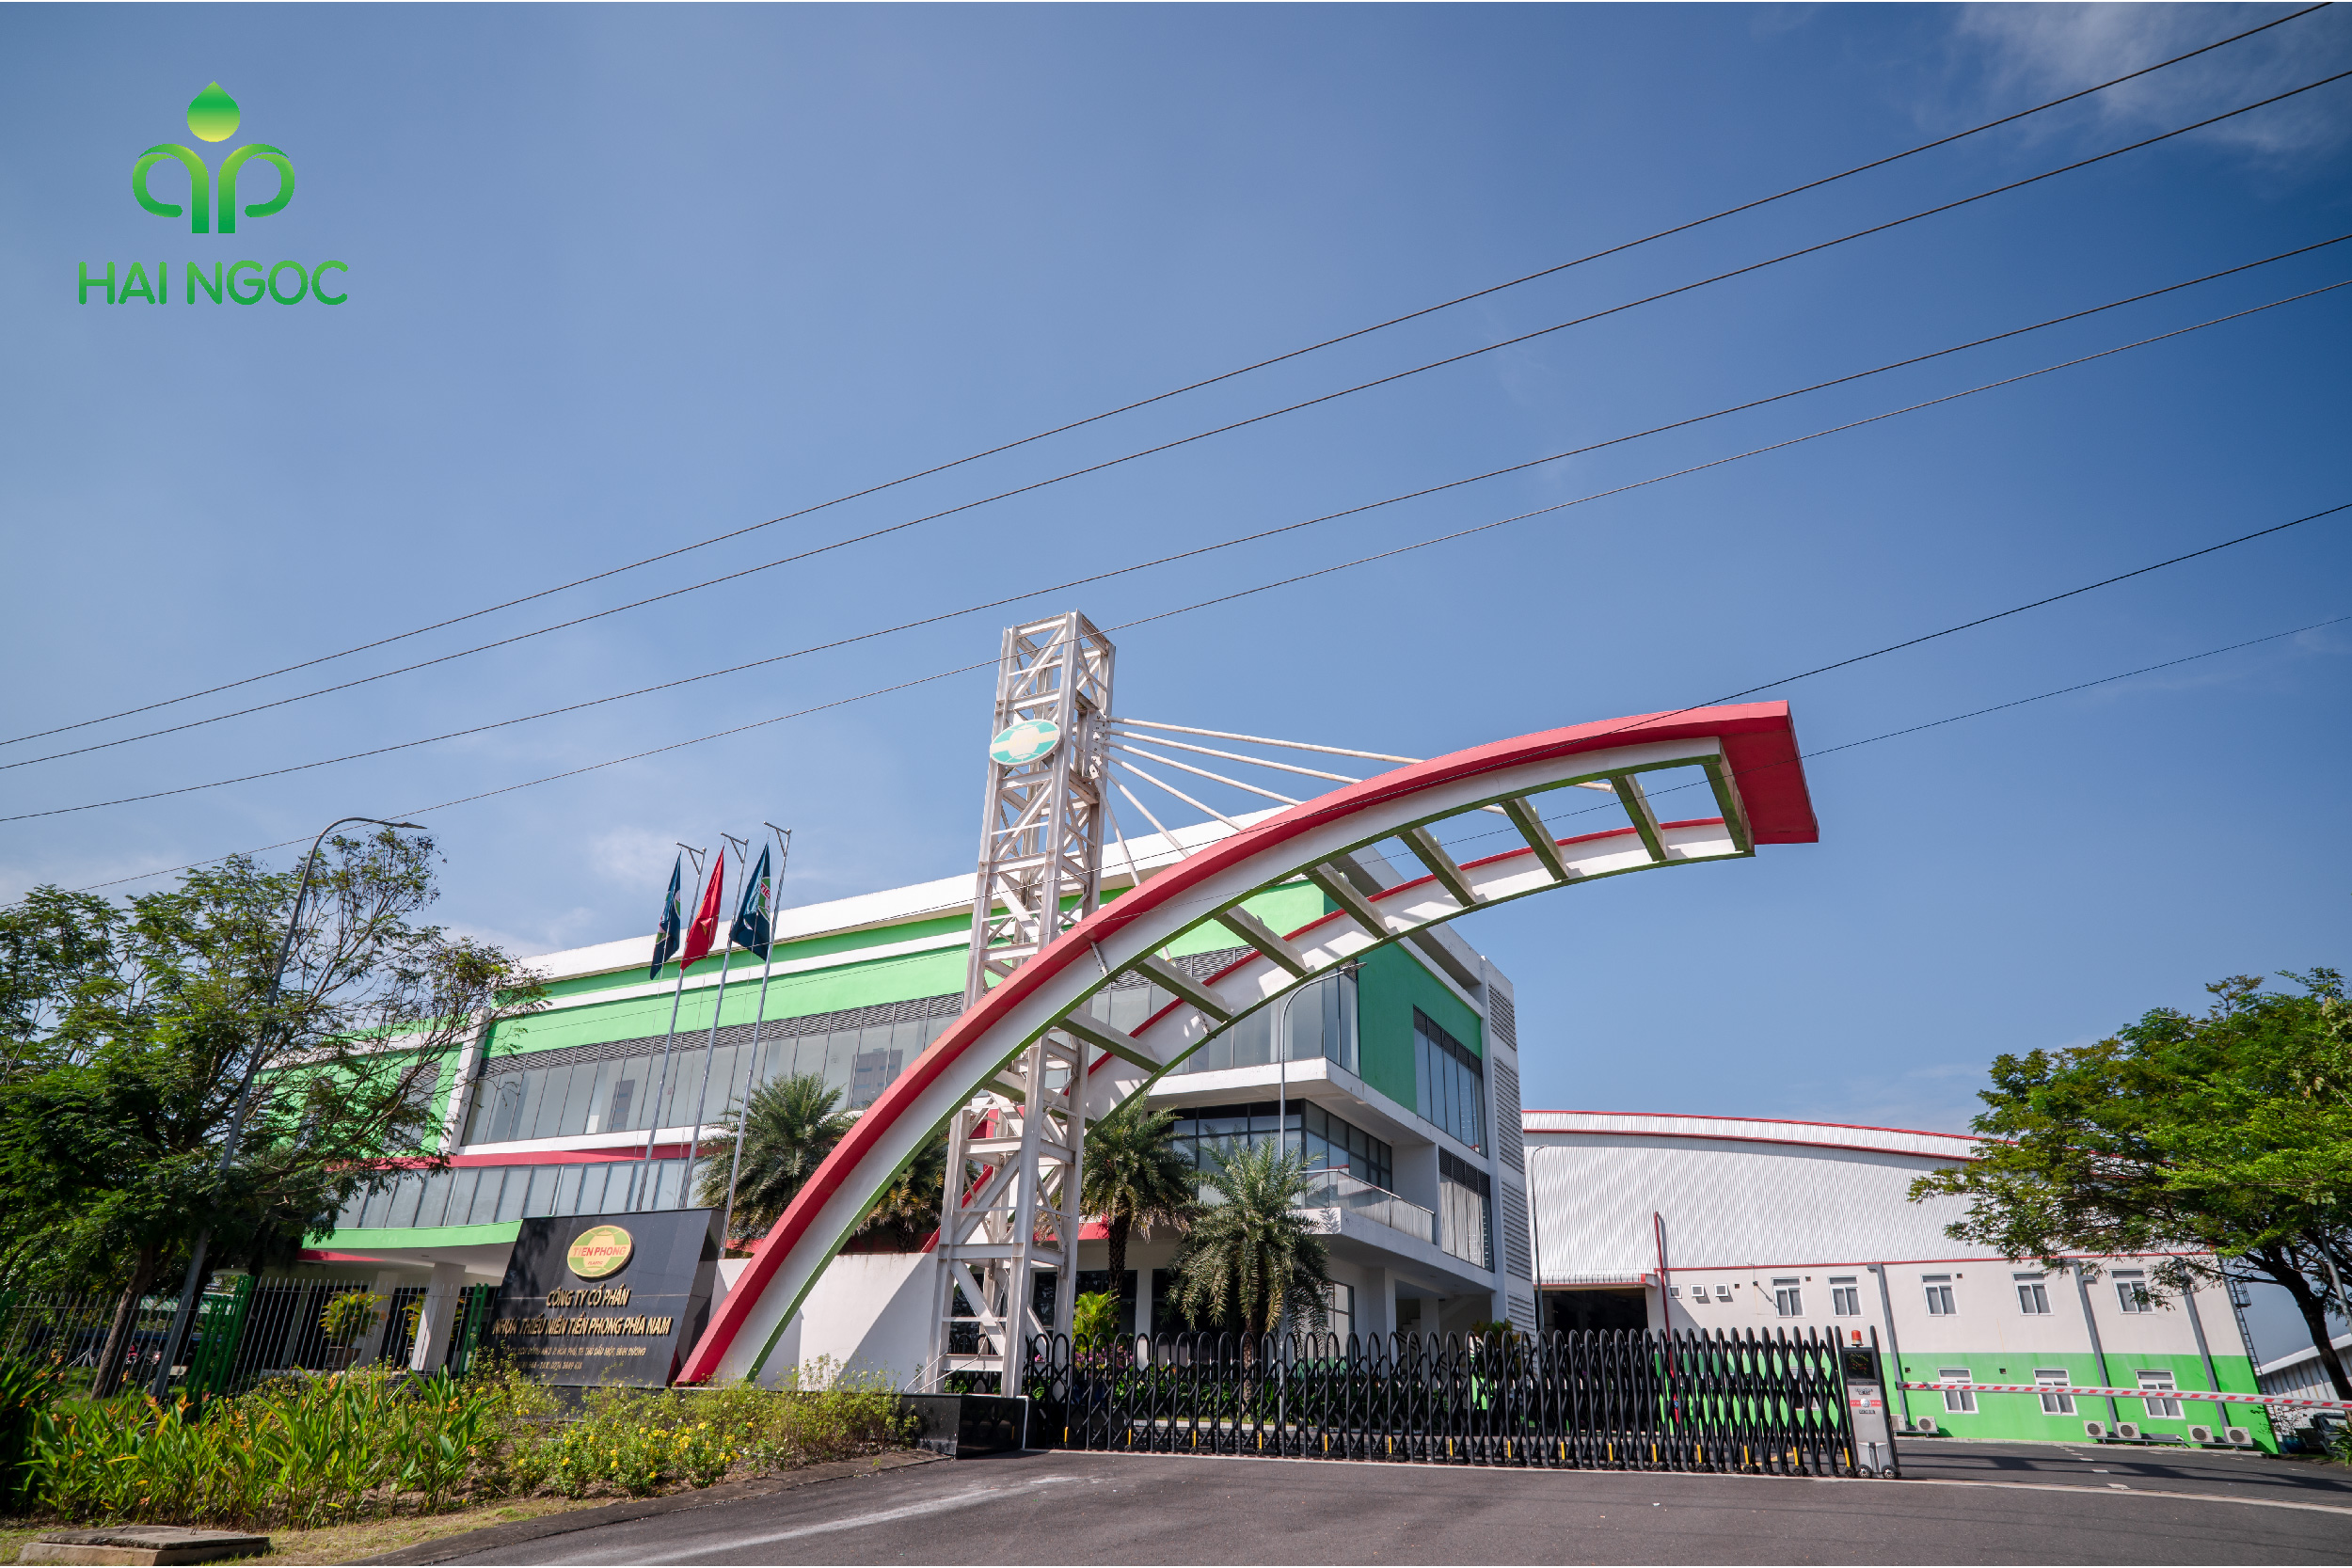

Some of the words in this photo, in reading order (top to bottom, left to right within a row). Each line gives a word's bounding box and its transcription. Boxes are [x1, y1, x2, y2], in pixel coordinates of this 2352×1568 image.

[573, 1247, 594, 1257] TIEN
[594, 1246, 628, 1257] PHONG
[546, 1286, 573, 1307] CÔNG
[574, 1290, 589, 1307] TY
[519, 1313, 547, 1334] THIẾU
[546, 1314, 568, 1334] NIÊN
[588, 1317, 623, 1334] PHONG
[622, 1314, 646, 1334] PHÍA
[646, 1317, 672, 1334] NAM
